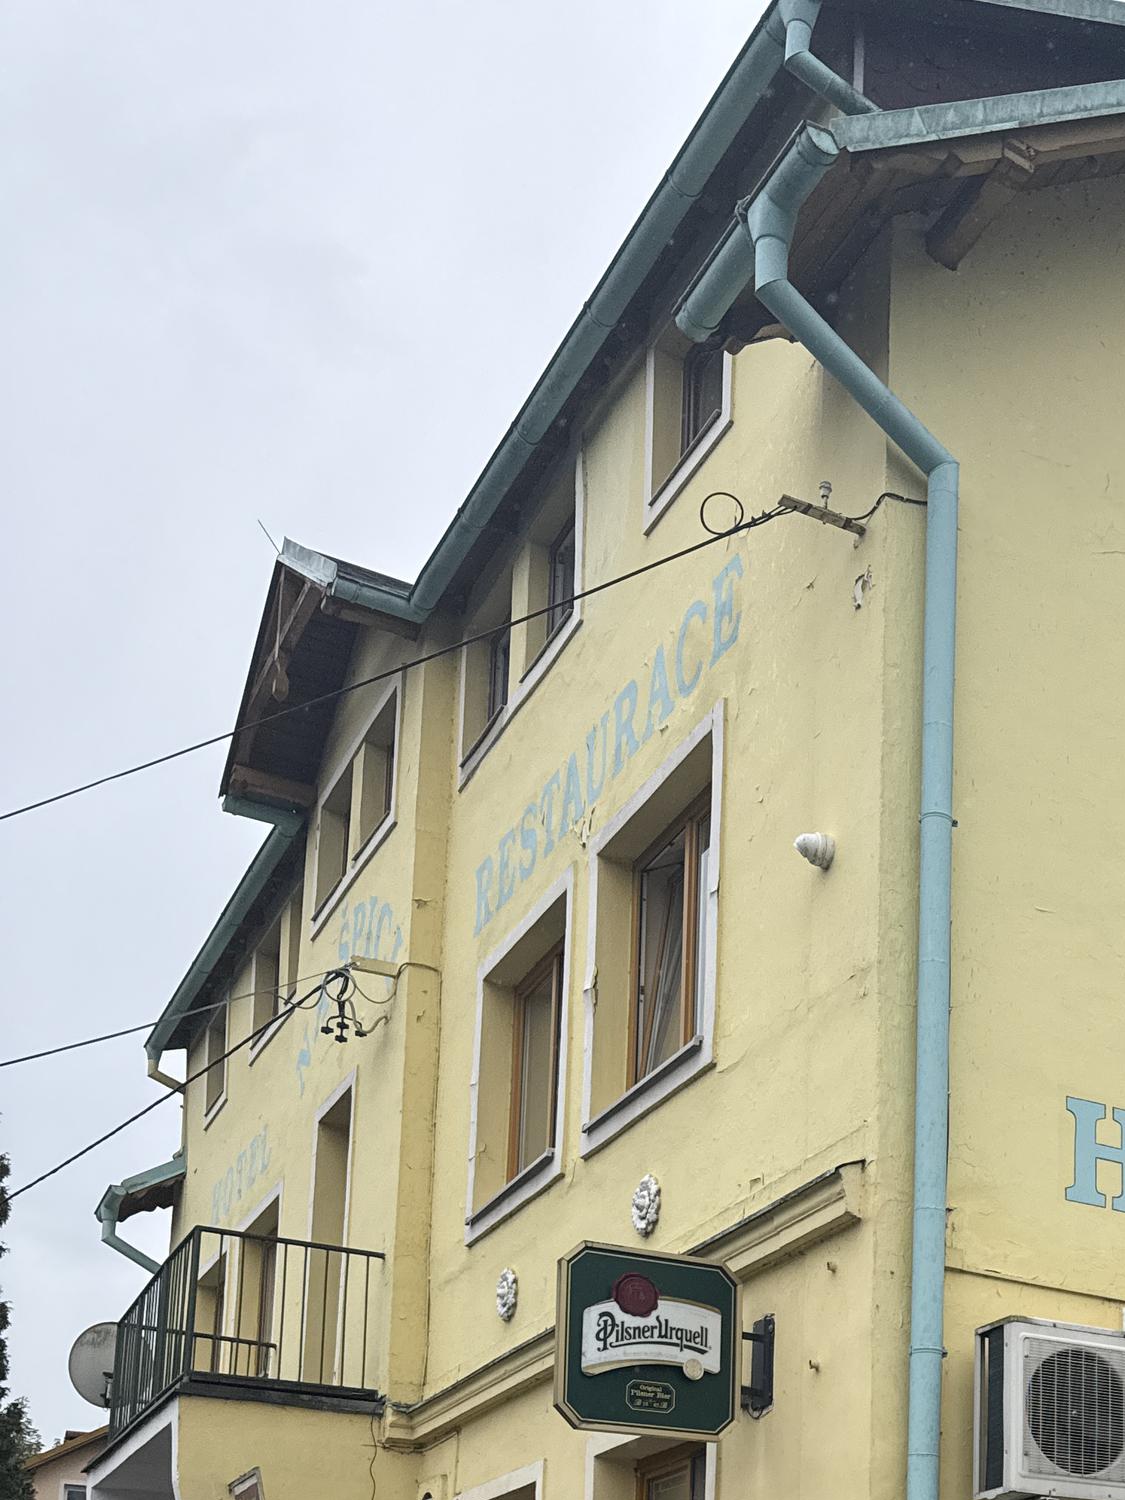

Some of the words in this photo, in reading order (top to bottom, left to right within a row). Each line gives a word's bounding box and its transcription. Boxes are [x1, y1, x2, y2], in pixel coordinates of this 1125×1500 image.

[474, 552, 743, 938] RESTAURACE
[595, 1311, 658, 1352] Pilsner
[656, 1315, 709, 1352] Urquell
